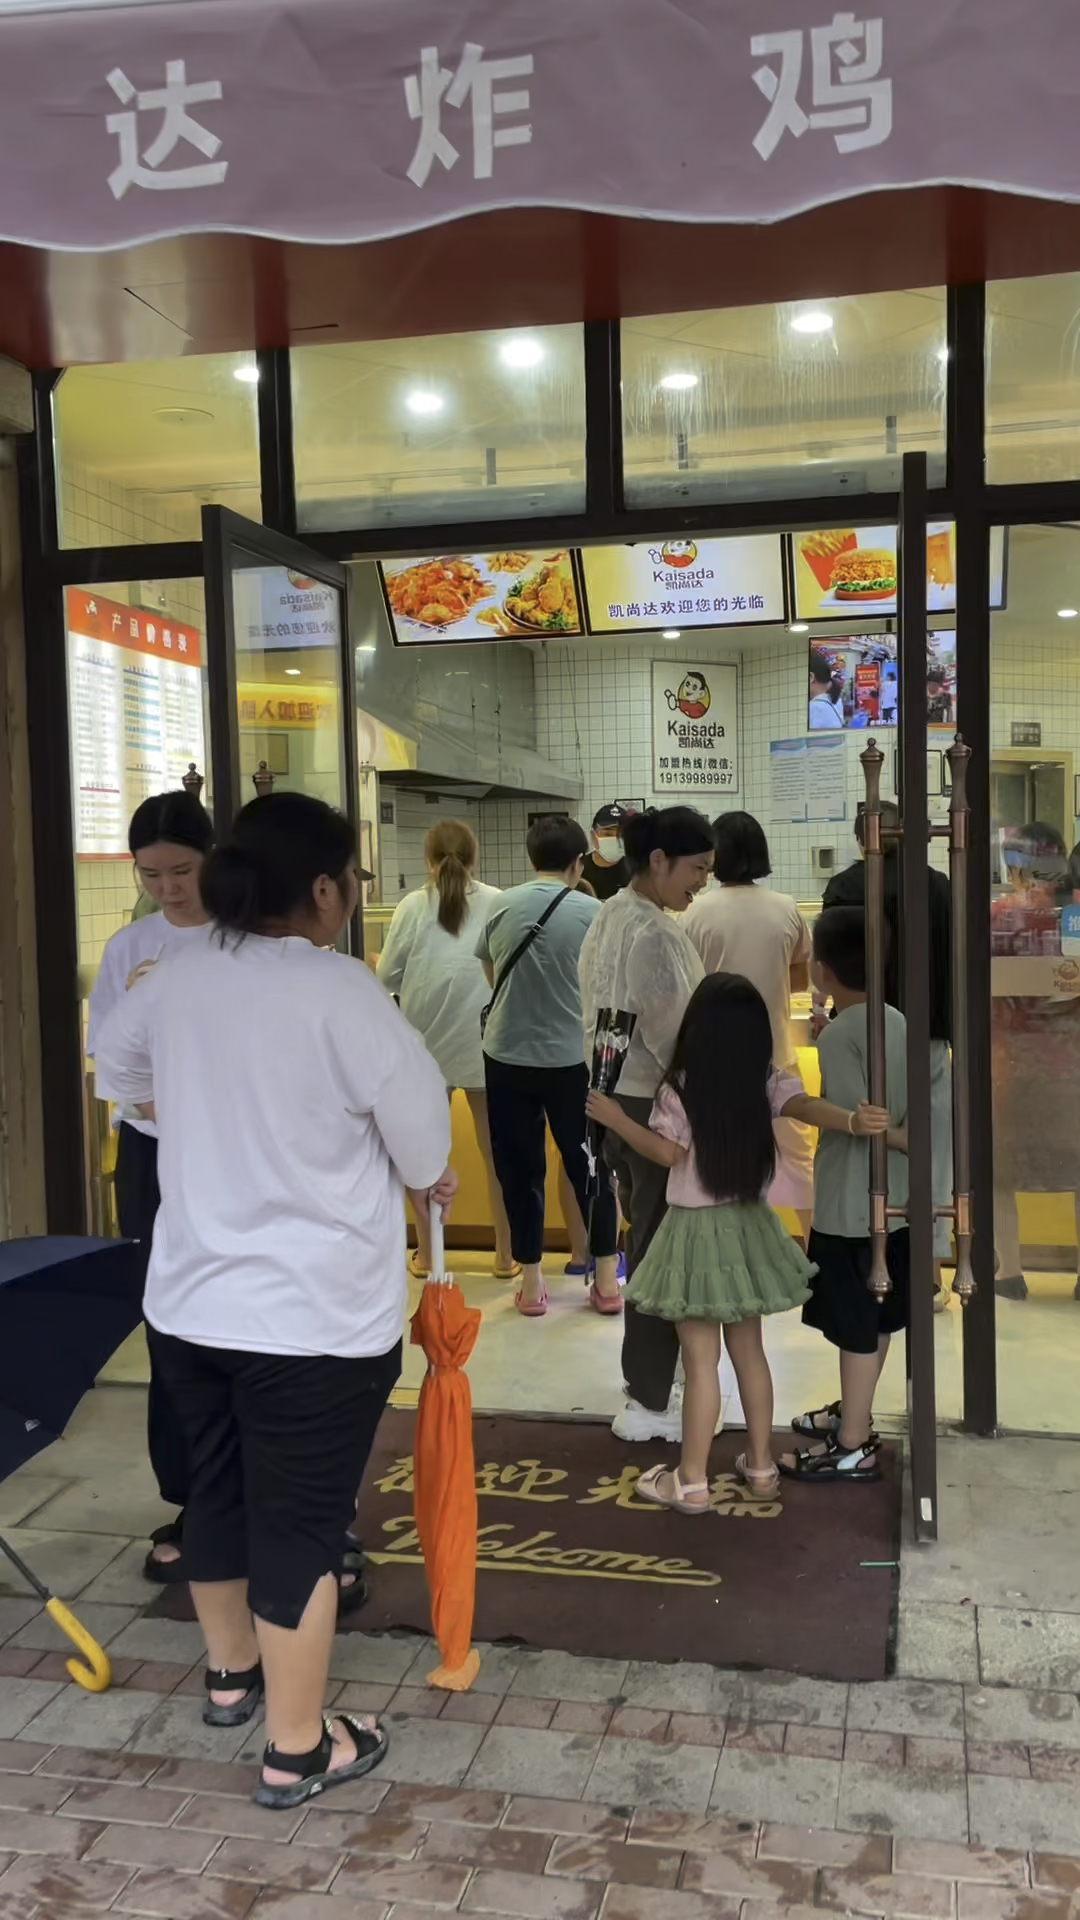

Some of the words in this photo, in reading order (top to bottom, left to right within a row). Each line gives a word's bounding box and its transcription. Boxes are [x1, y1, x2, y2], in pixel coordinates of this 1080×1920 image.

[106, 13, 893, 200] 达炸鸡
[653, 568, 714, 582] Kaisada
[608, 595, 764, 618] 凯尚达欢迎您的光临
[667, 720, 725, 737] Kaisada
[678, 737, 715, 749] 凯尚达
[659, 772, 733, 784] 19139989997
